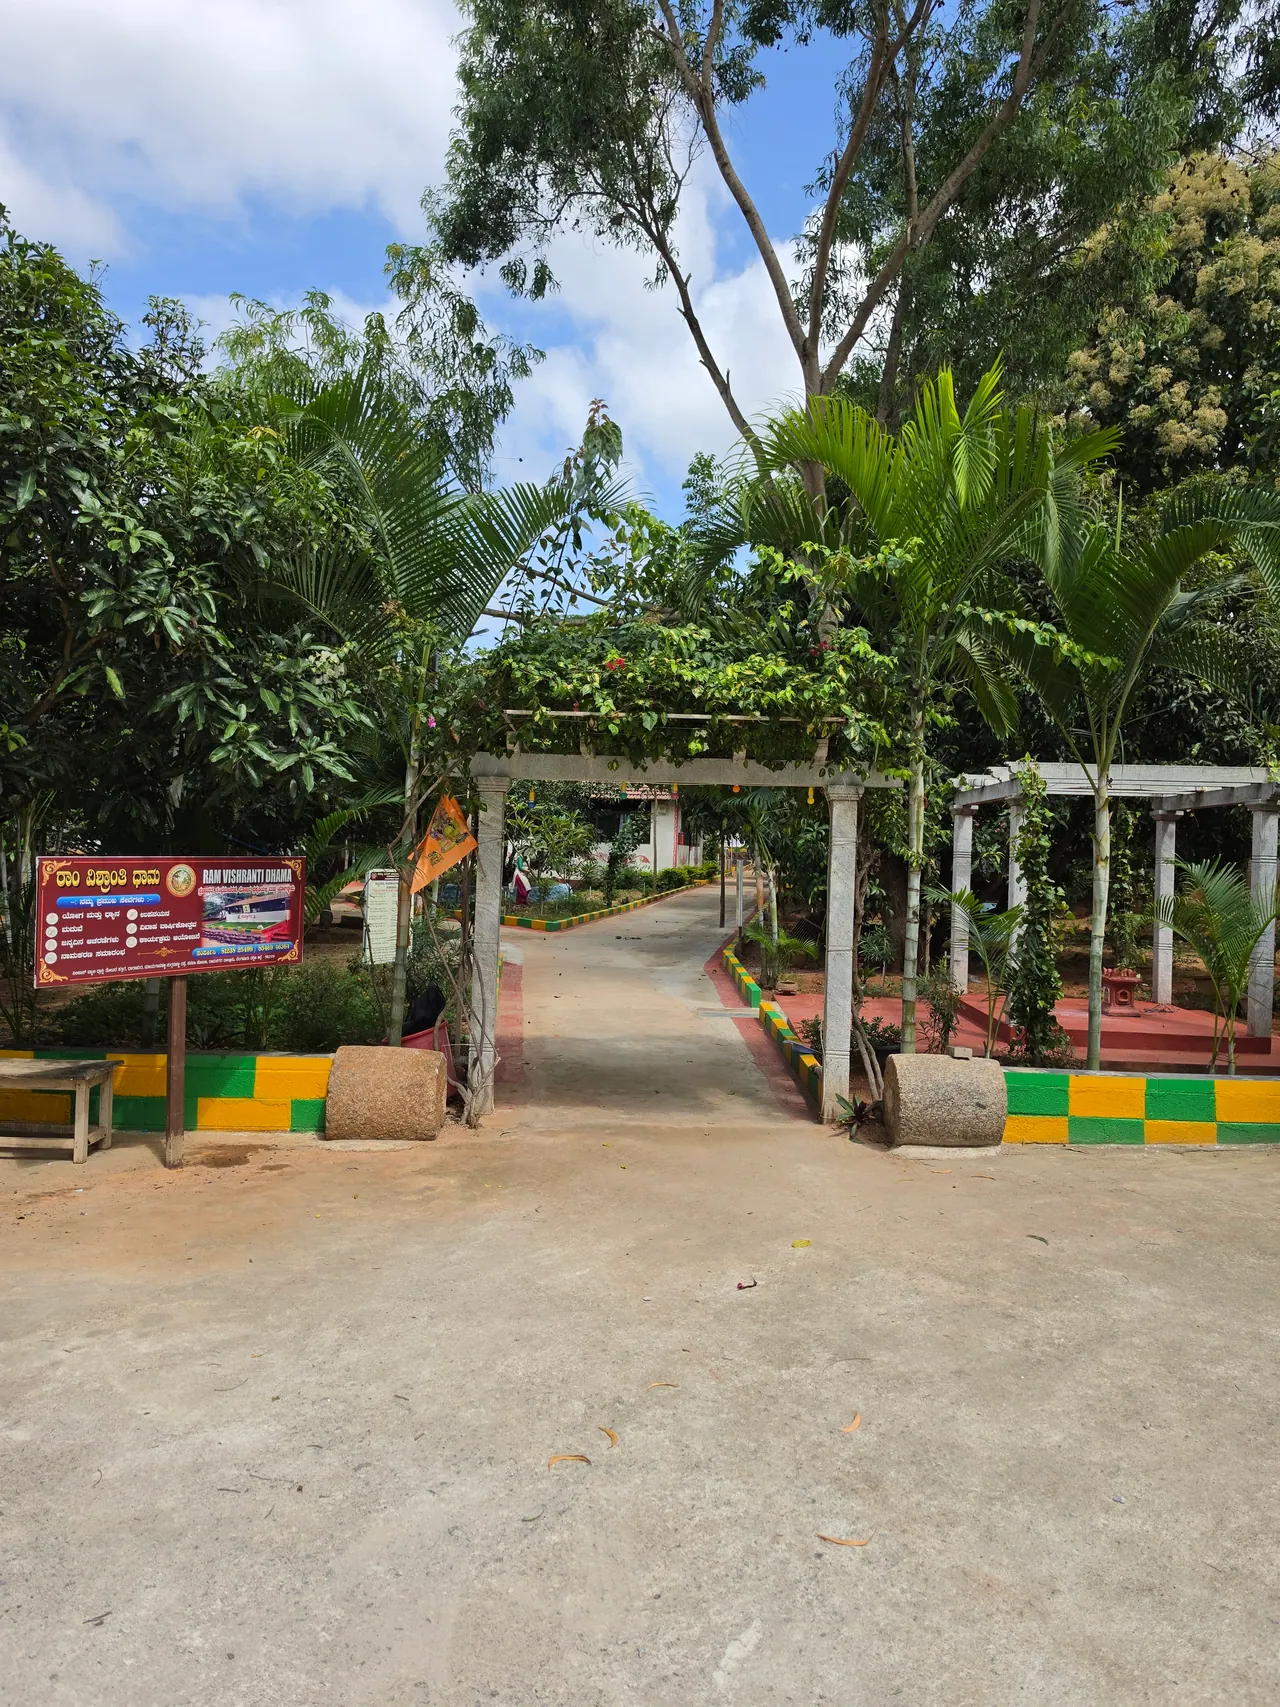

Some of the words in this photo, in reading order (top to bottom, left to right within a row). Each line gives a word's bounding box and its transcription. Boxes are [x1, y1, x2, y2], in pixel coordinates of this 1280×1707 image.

[56, 870, 81, 887] ರಾಂ
[86, 868, 127, 893] ವಿಶ್ರಾಂತಿ
[132, 868, 160, 888] ಧಾಮ
[202, 869, 221, 884] RAM
[222, 868, 264, 884] VISHRANTI
[265, 868, 292, 883] DHAMA
